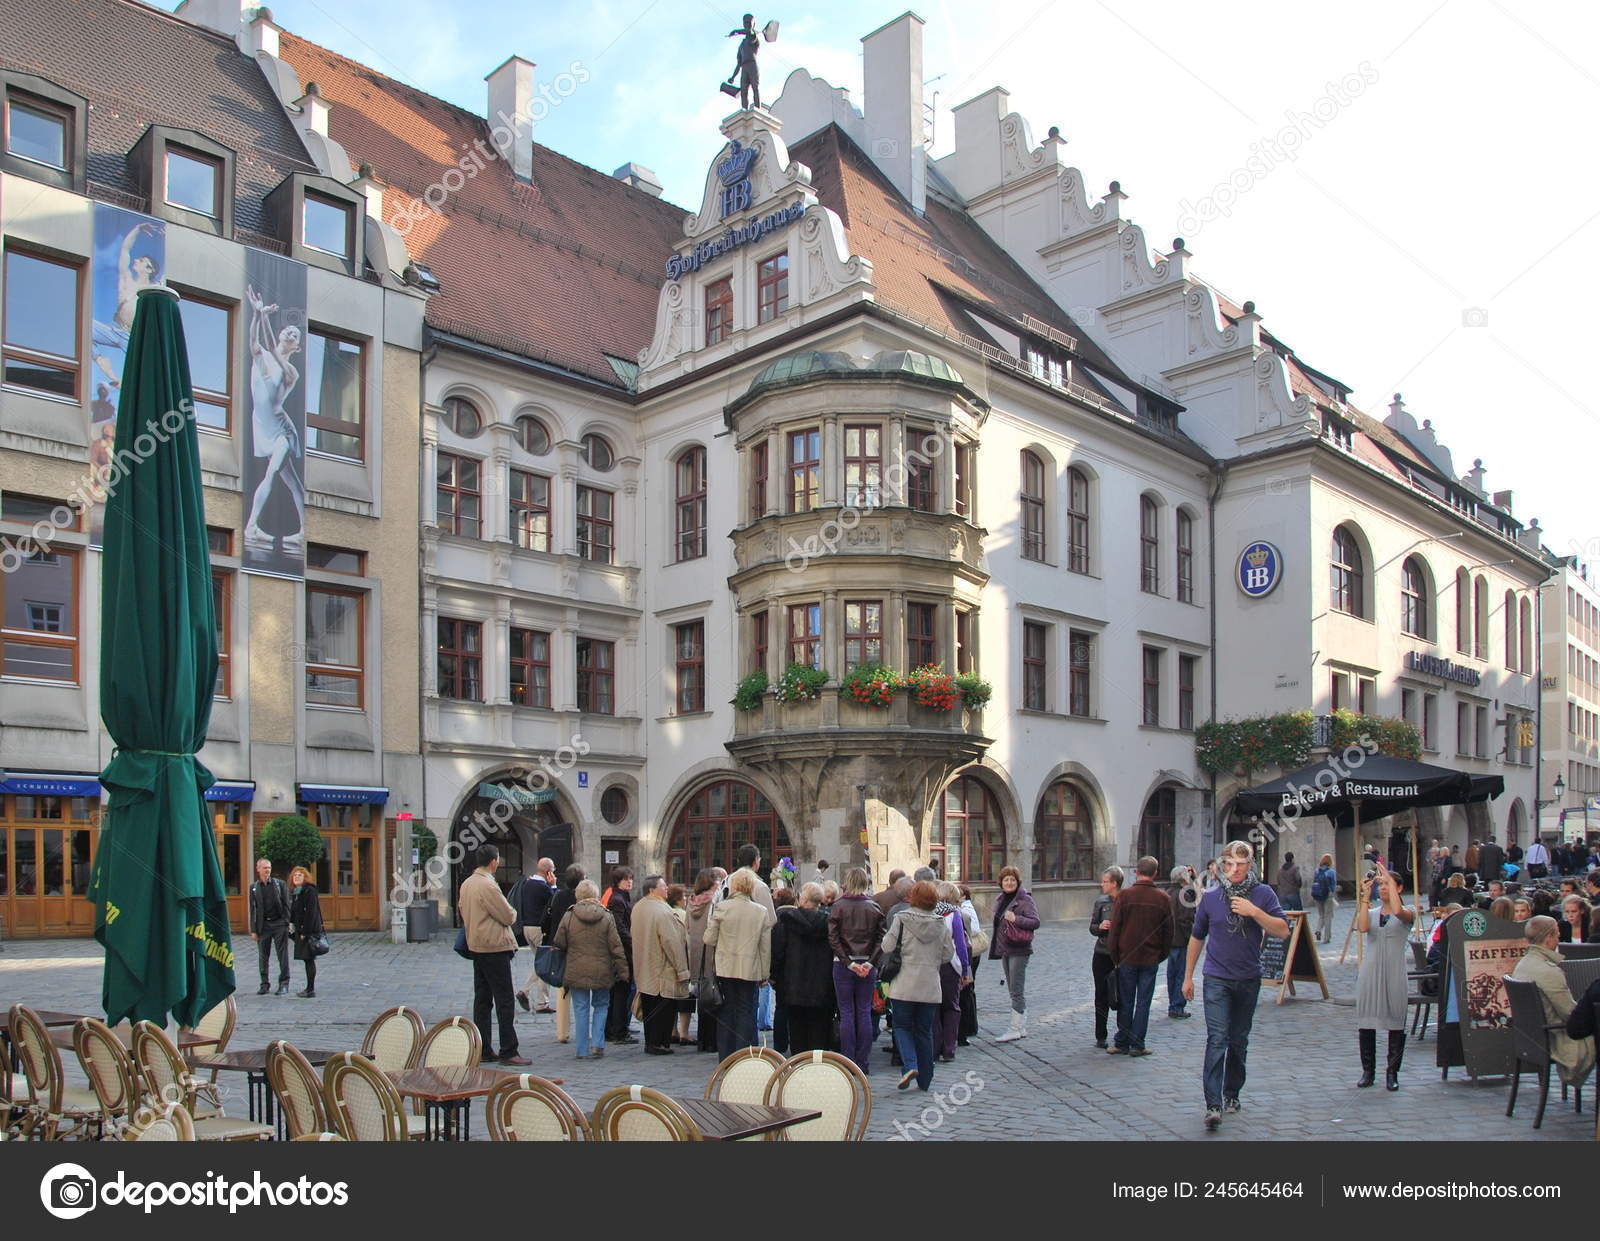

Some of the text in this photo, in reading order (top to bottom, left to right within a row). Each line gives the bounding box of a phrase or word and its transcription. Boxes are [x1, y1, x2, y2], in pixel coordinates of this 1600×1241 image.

[720, 177, 752, 218] HB
[1246, 567, 1269, 589] HB
[1282, 781, 1419, 807] Bakery & Restaurant
[1469, 947, 1527, 960] KAFFEE
